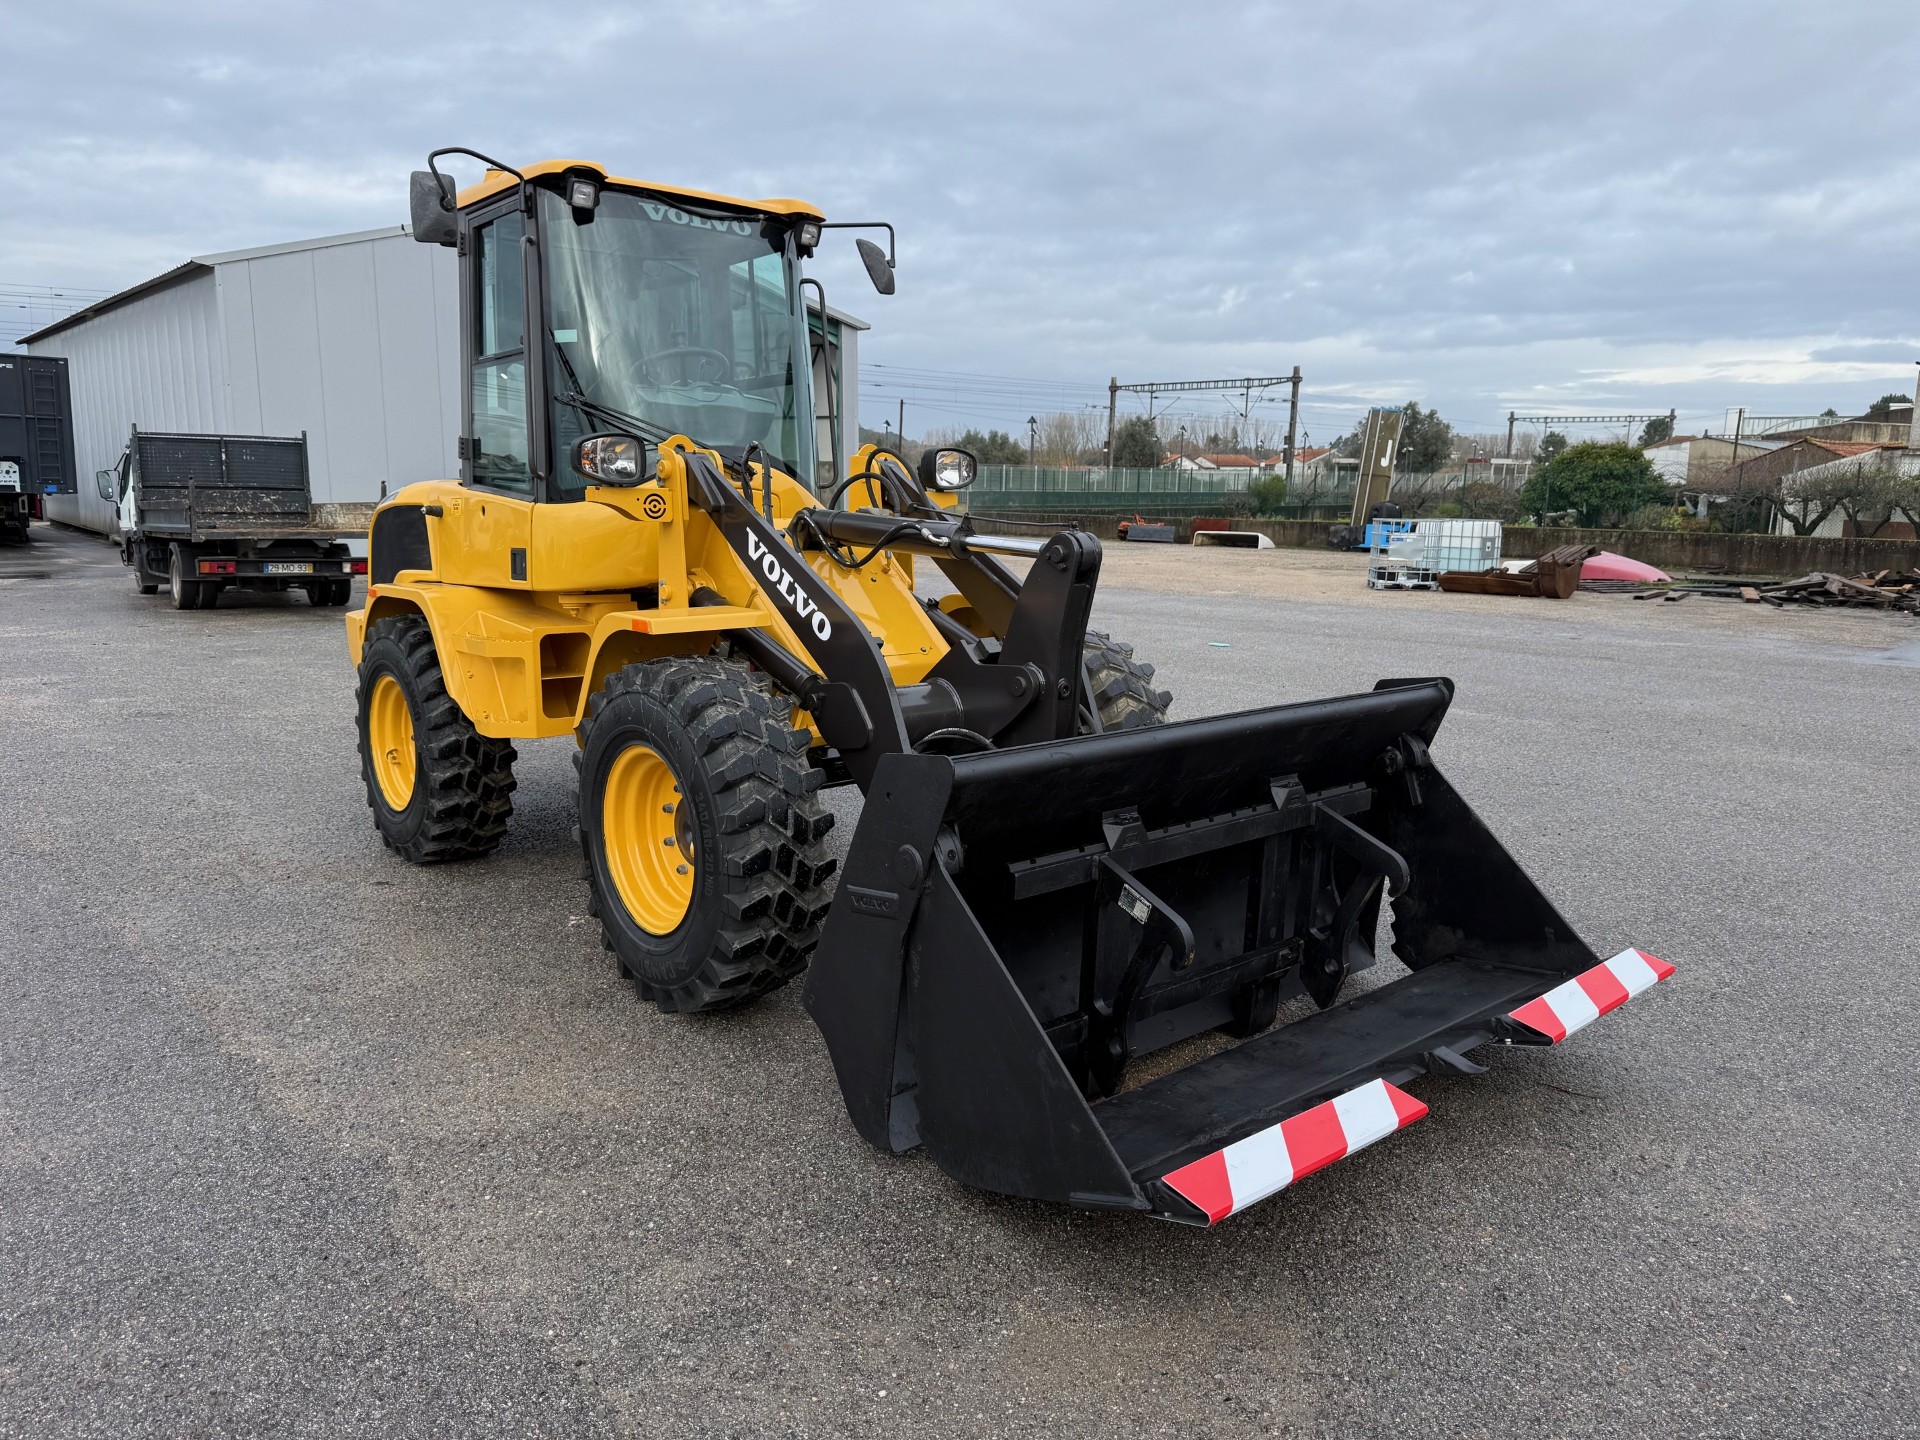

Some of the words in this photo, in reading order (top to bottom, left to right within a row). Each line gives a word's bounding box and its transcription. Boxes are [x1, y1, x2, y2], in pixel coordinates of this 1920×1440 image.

[638, 202, 752, 236] VOLVO
[746, 526, 832, 641] VOLVO
[850, 895, 889, 912] VOLVO
